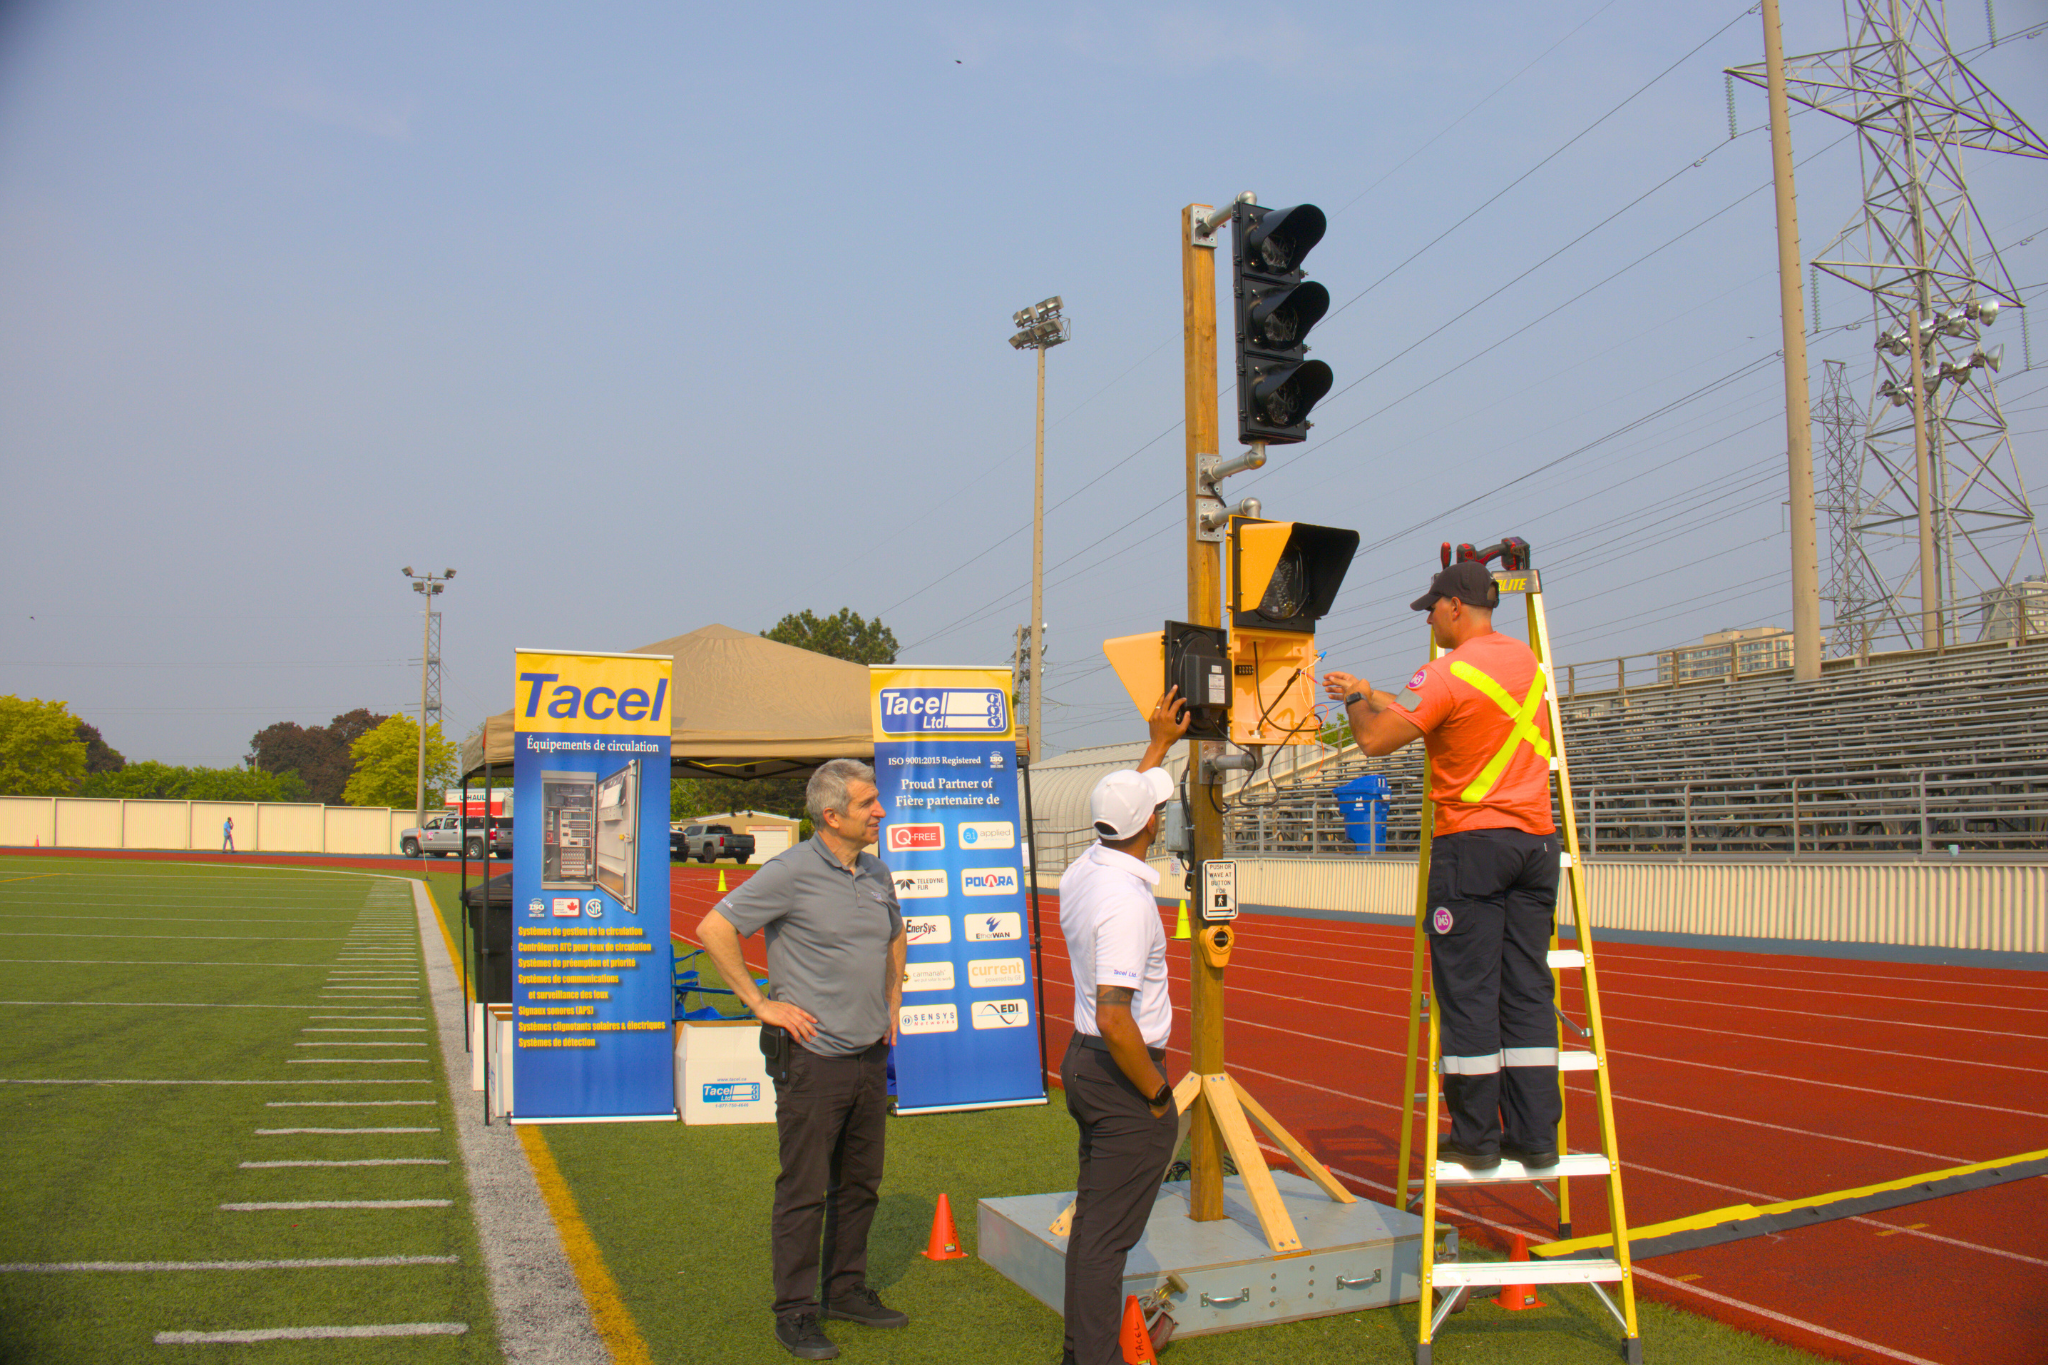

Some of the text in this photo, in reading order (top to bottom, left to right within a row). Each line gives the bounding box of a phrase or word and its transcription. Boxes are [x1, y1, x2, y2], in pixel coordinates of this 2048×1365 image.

[520, 672, 668, 721] Tacel
[882, 692, 947, 715] Tacel
[527, 735, 659, 752] Équipements de circulation
[942, 757, 981, 766] Registered
[901, 778, 993, 790] Proud Partner of
[896, 794, 1000, 809] Fière partenaire de
[896, 829, 936, 845] Q-FREE
[980, 829, 1010, 837] applied
[965, 874, 1014, 887] POLARA
[1436, 915, 1448, 926] TM3
[518, 926, 642, 937] Systèmes de gestion de la circulation
[906, 920, 936, 934] EnerSys
[518, 942, 651, 952] Contrôleurs ATC pour feux de circulation
[518, 958, 635, 968] Systèmes de préemption et priorité
[972, 962, 1021, 976] current
[518, 974, 618, 984] Systèmes de communications
[536, 990, 579, 999] surveillance
[580, 990, 592, 999] des
[594, 990, 608, 999] feux
[518, 1006, 546, 1016] Signaux
[576, 1006, 594, 1015] (APS)
[1001, 1004, 1018, 1013] EDI
[914, 1012, 954, 1021] SENSYS
[519, 1022, 551, 1032] Systèmes
[553, 1022, 591, 1032] clignotants
[592, 1022, 620, 1030] solaires
[627, 1021, 666, 1030] électriques
[519, 1037, 595, 1048] Systèmes de détection
[704, 1085, 733, 1095] Tacel
[1134, 1322, 1145, 1359] TACEL
